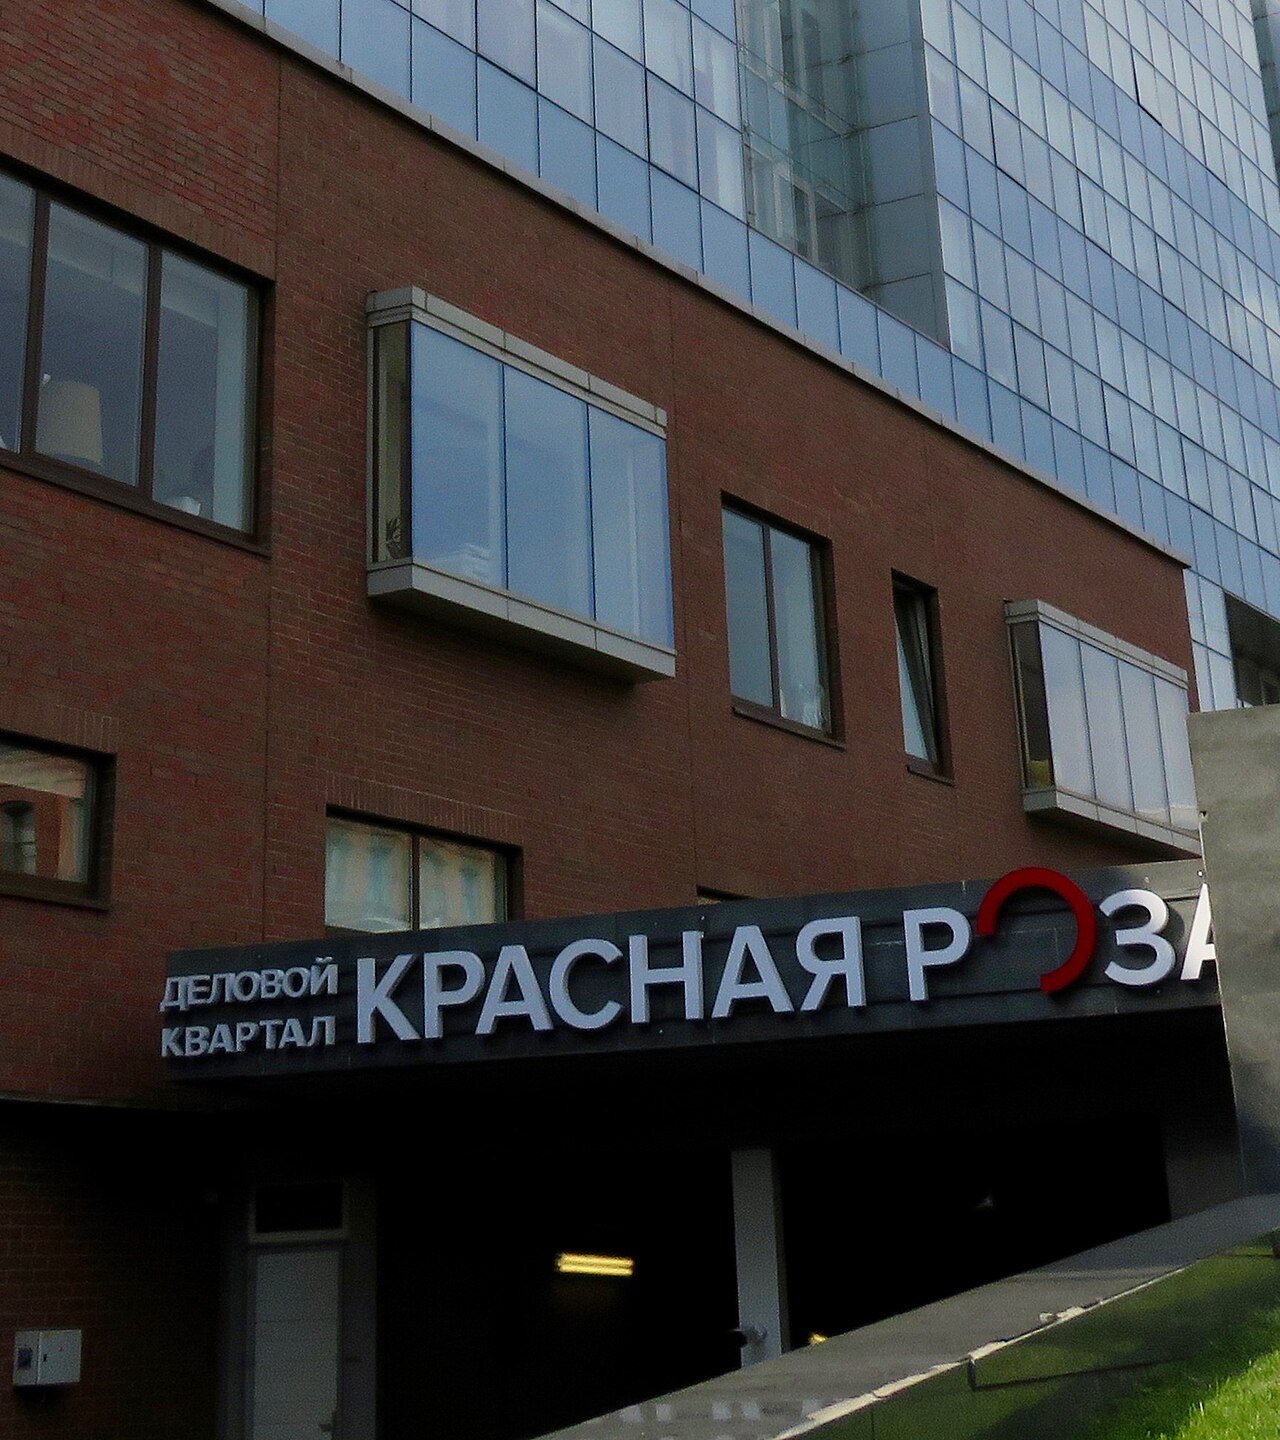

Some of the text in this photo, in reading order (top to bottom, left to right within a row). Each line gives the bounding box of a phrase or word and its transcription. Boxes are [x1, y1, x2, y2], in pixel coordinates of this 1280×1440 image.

[160, 957, 338, 1012] ДЕЛОВОЙ
[357, 916, 867, 1044] КРАСНАЯ
[160, 1015, 336, 1058] КВАРТАЛ
